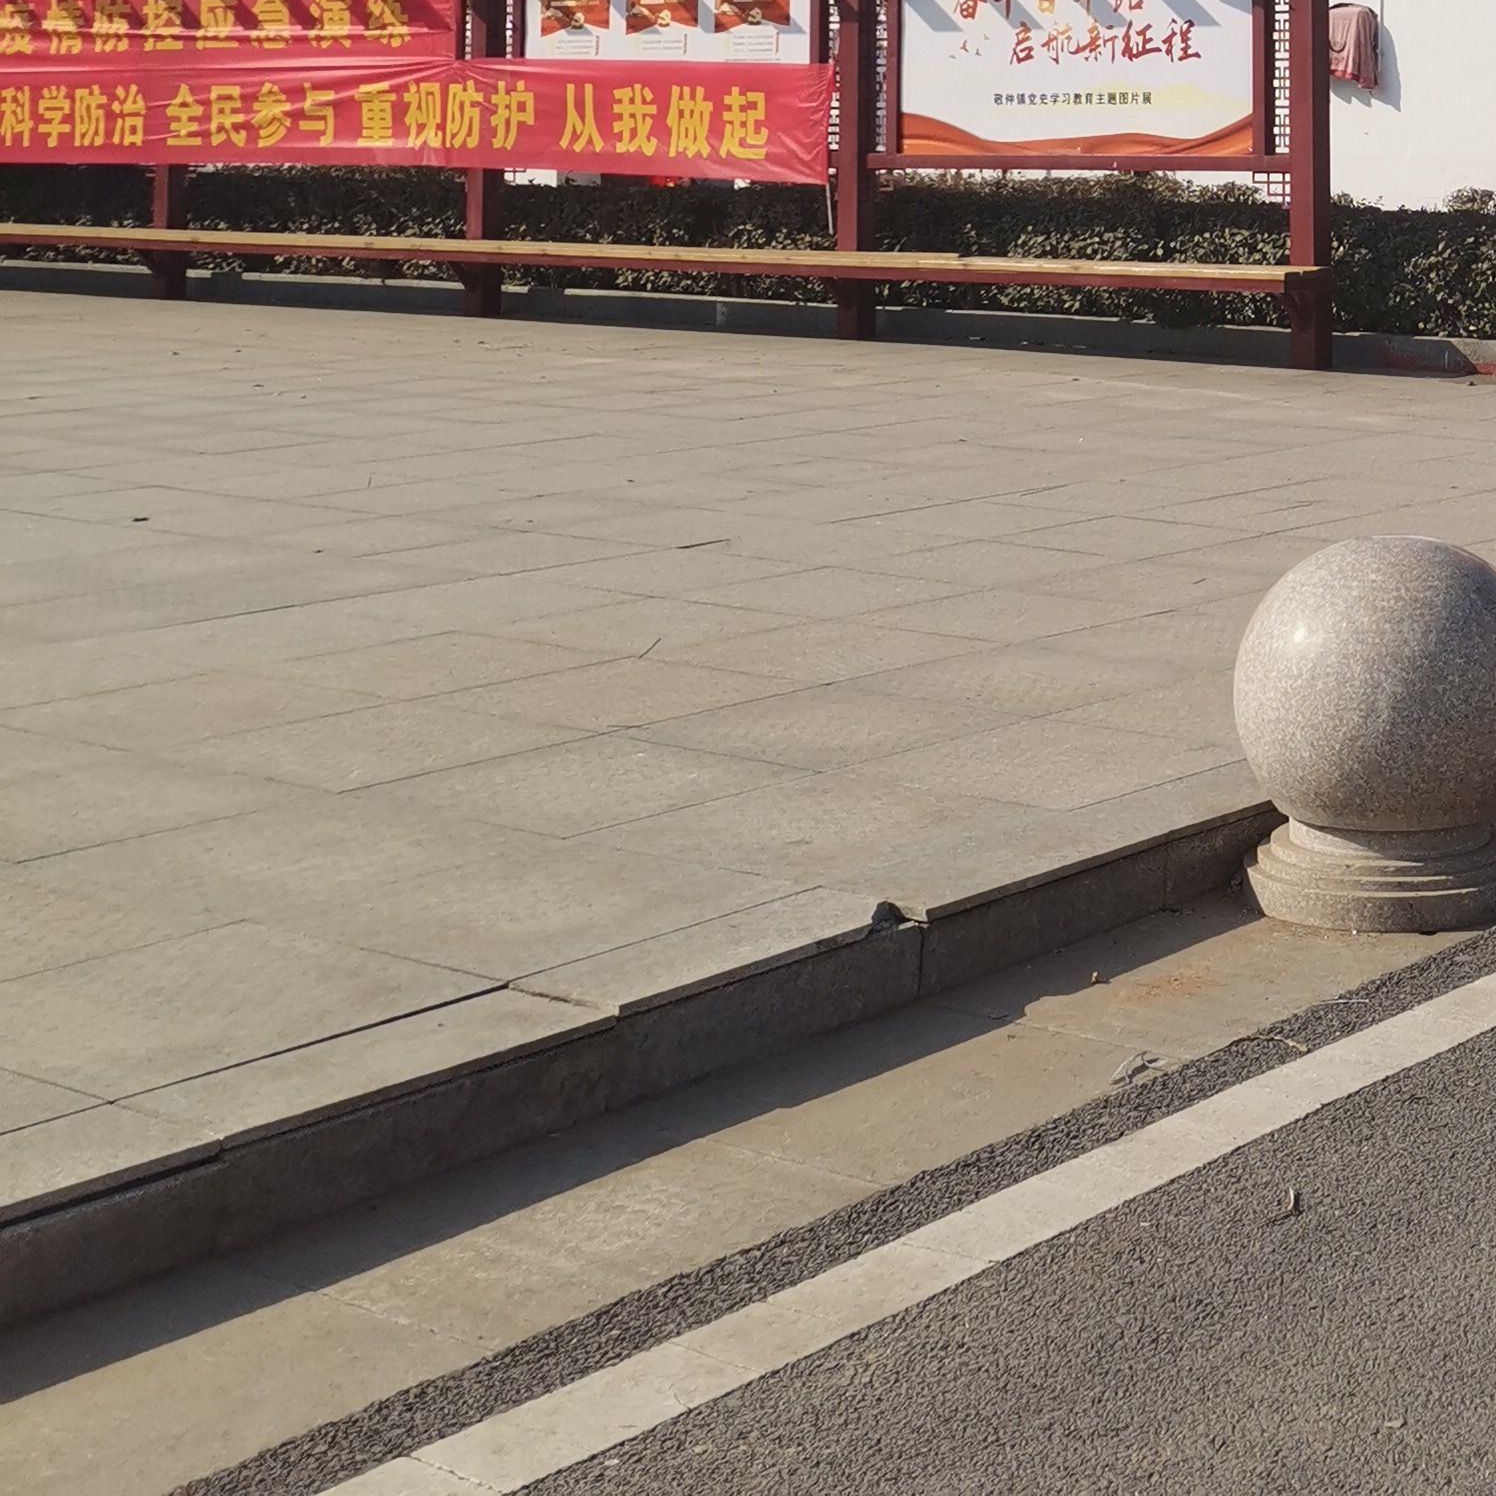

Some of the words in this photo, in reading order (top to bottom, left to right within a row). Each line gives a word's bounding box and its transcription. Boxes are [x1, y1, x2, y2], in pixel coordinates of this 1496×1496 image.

[1009, 18, 1202, 65] 启航新征程
[0, 84, 146, 148] 科学防治
[165, 82, 336, 149] 全民参与
[355, 80, 535, 151] 重视防护
[559, 83, 769, 160] 从我做起
